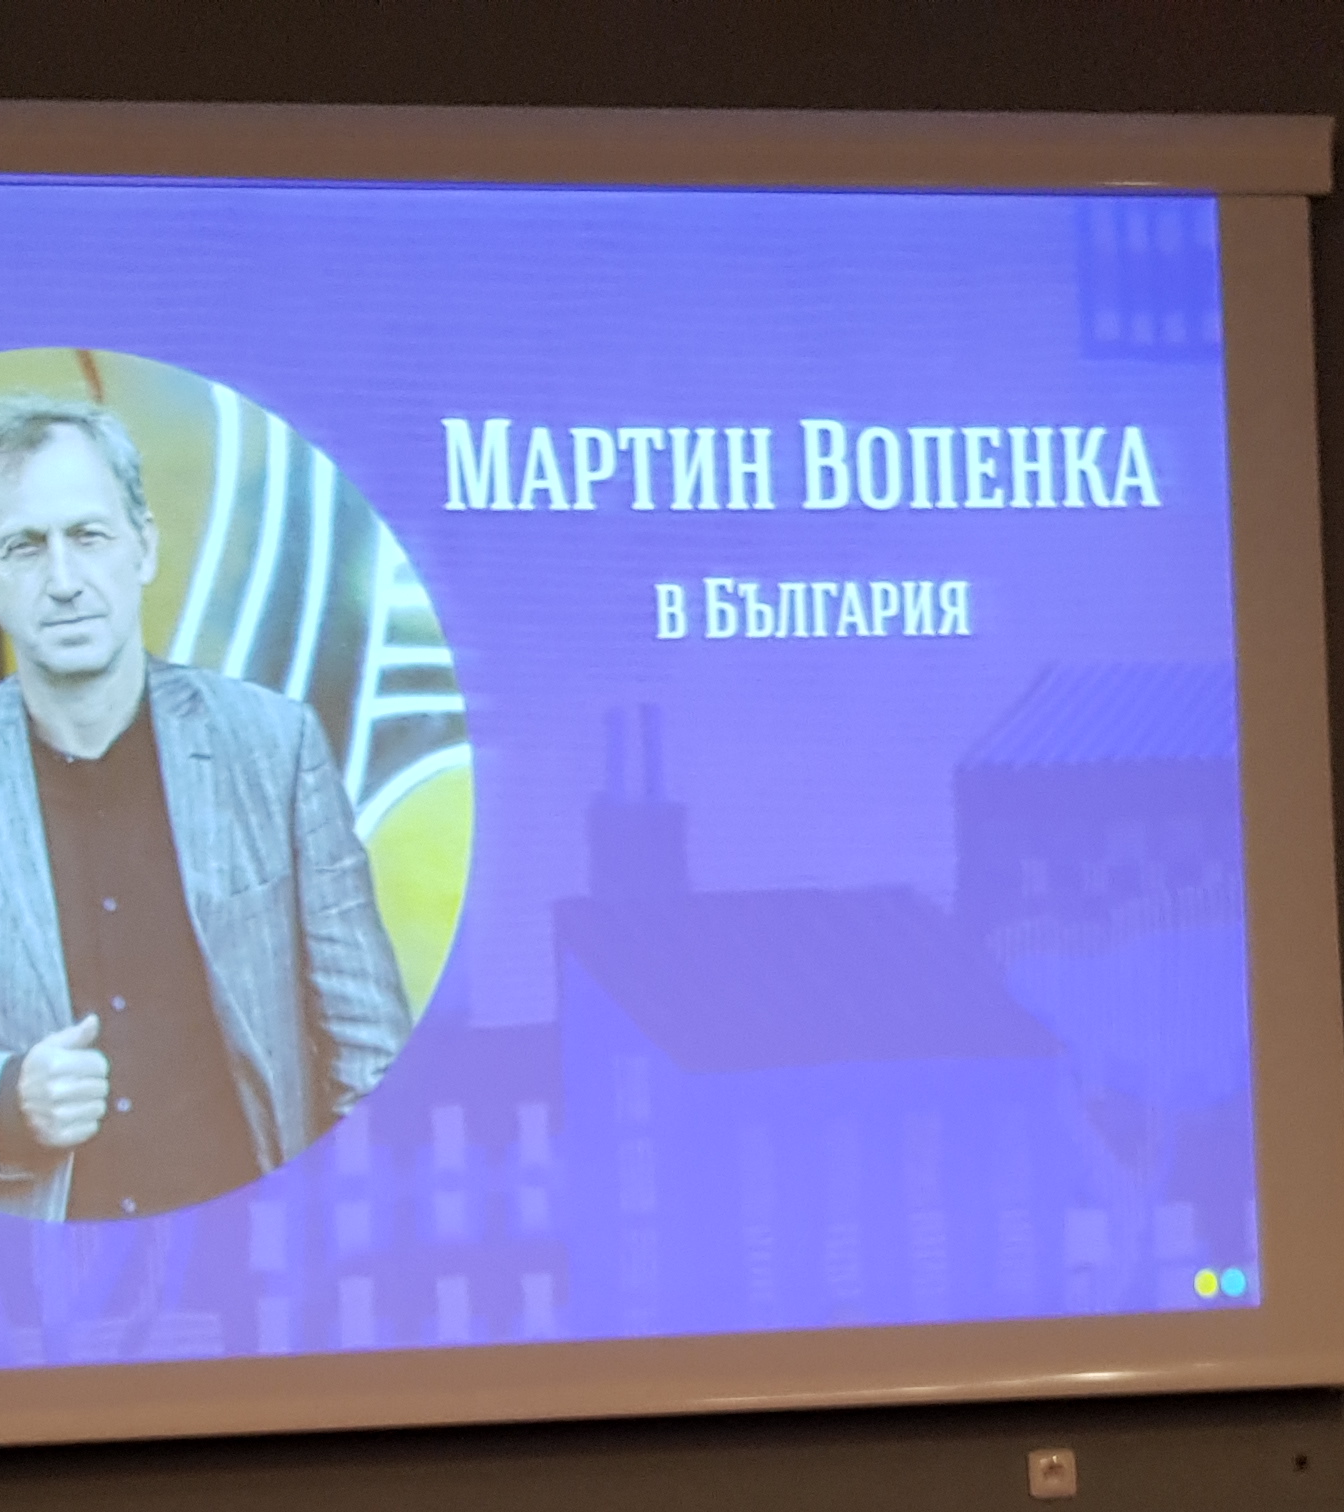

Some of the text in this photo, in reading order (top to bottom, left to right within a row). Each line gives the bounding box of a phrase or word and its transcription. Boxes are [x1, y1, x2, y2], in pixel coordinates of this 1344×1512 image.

[441, 417, 1162, 512] МАРТИН ВОПЕНКА
[703, 577, 971, 640] БЪЛГАРИЯ
